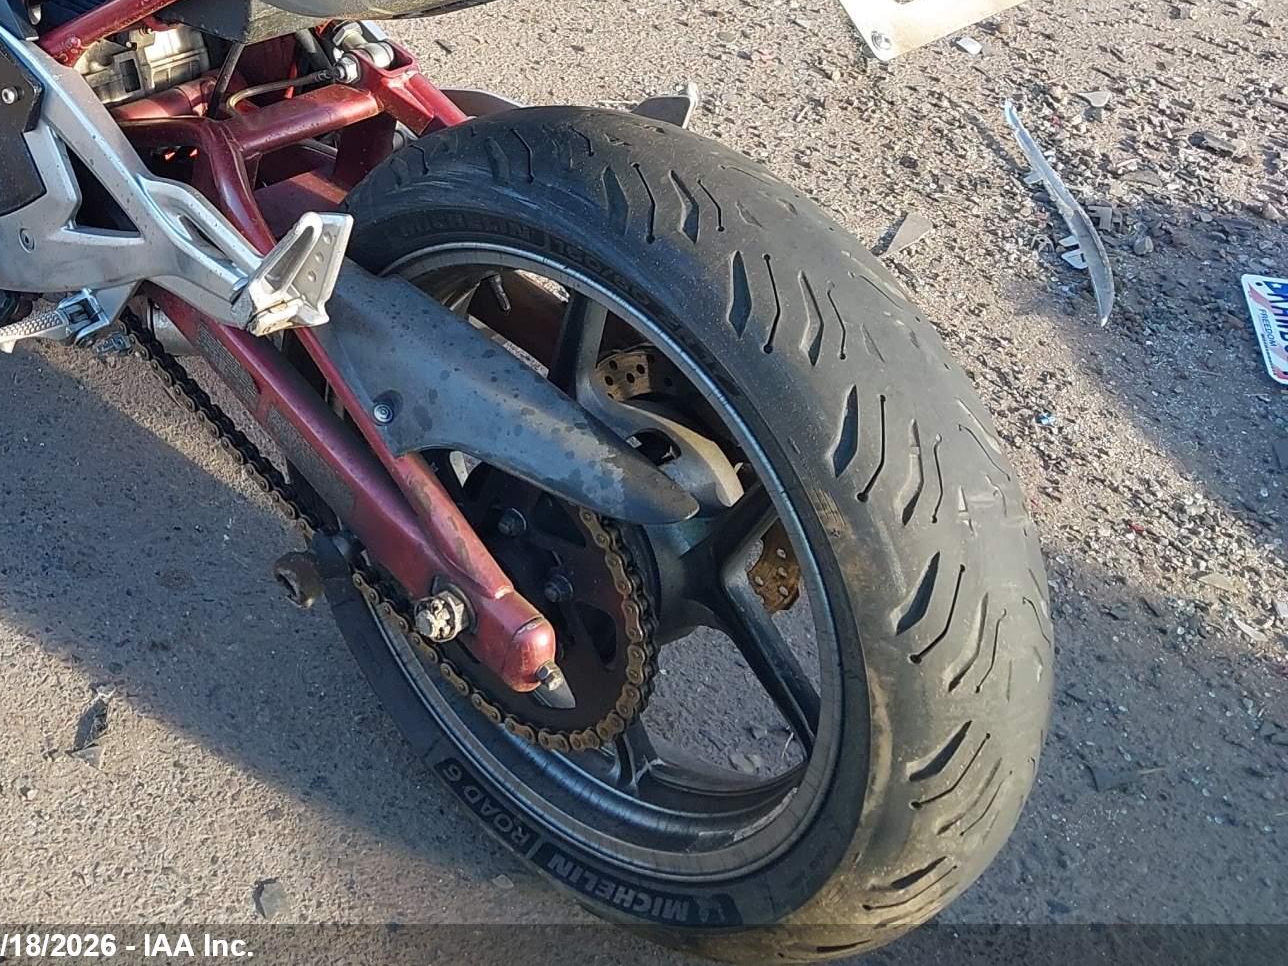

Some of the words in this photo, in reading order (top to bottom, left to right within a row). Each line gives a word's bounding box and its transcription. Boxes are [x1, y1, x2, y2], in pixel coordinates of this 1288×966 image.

[1260, 309, 1277, 347] FREEDOM
[442, 764, 461, 782] 6
[463, 786, 529, 845] ROAD
[547, 853, 689, 919] MICHELIN
